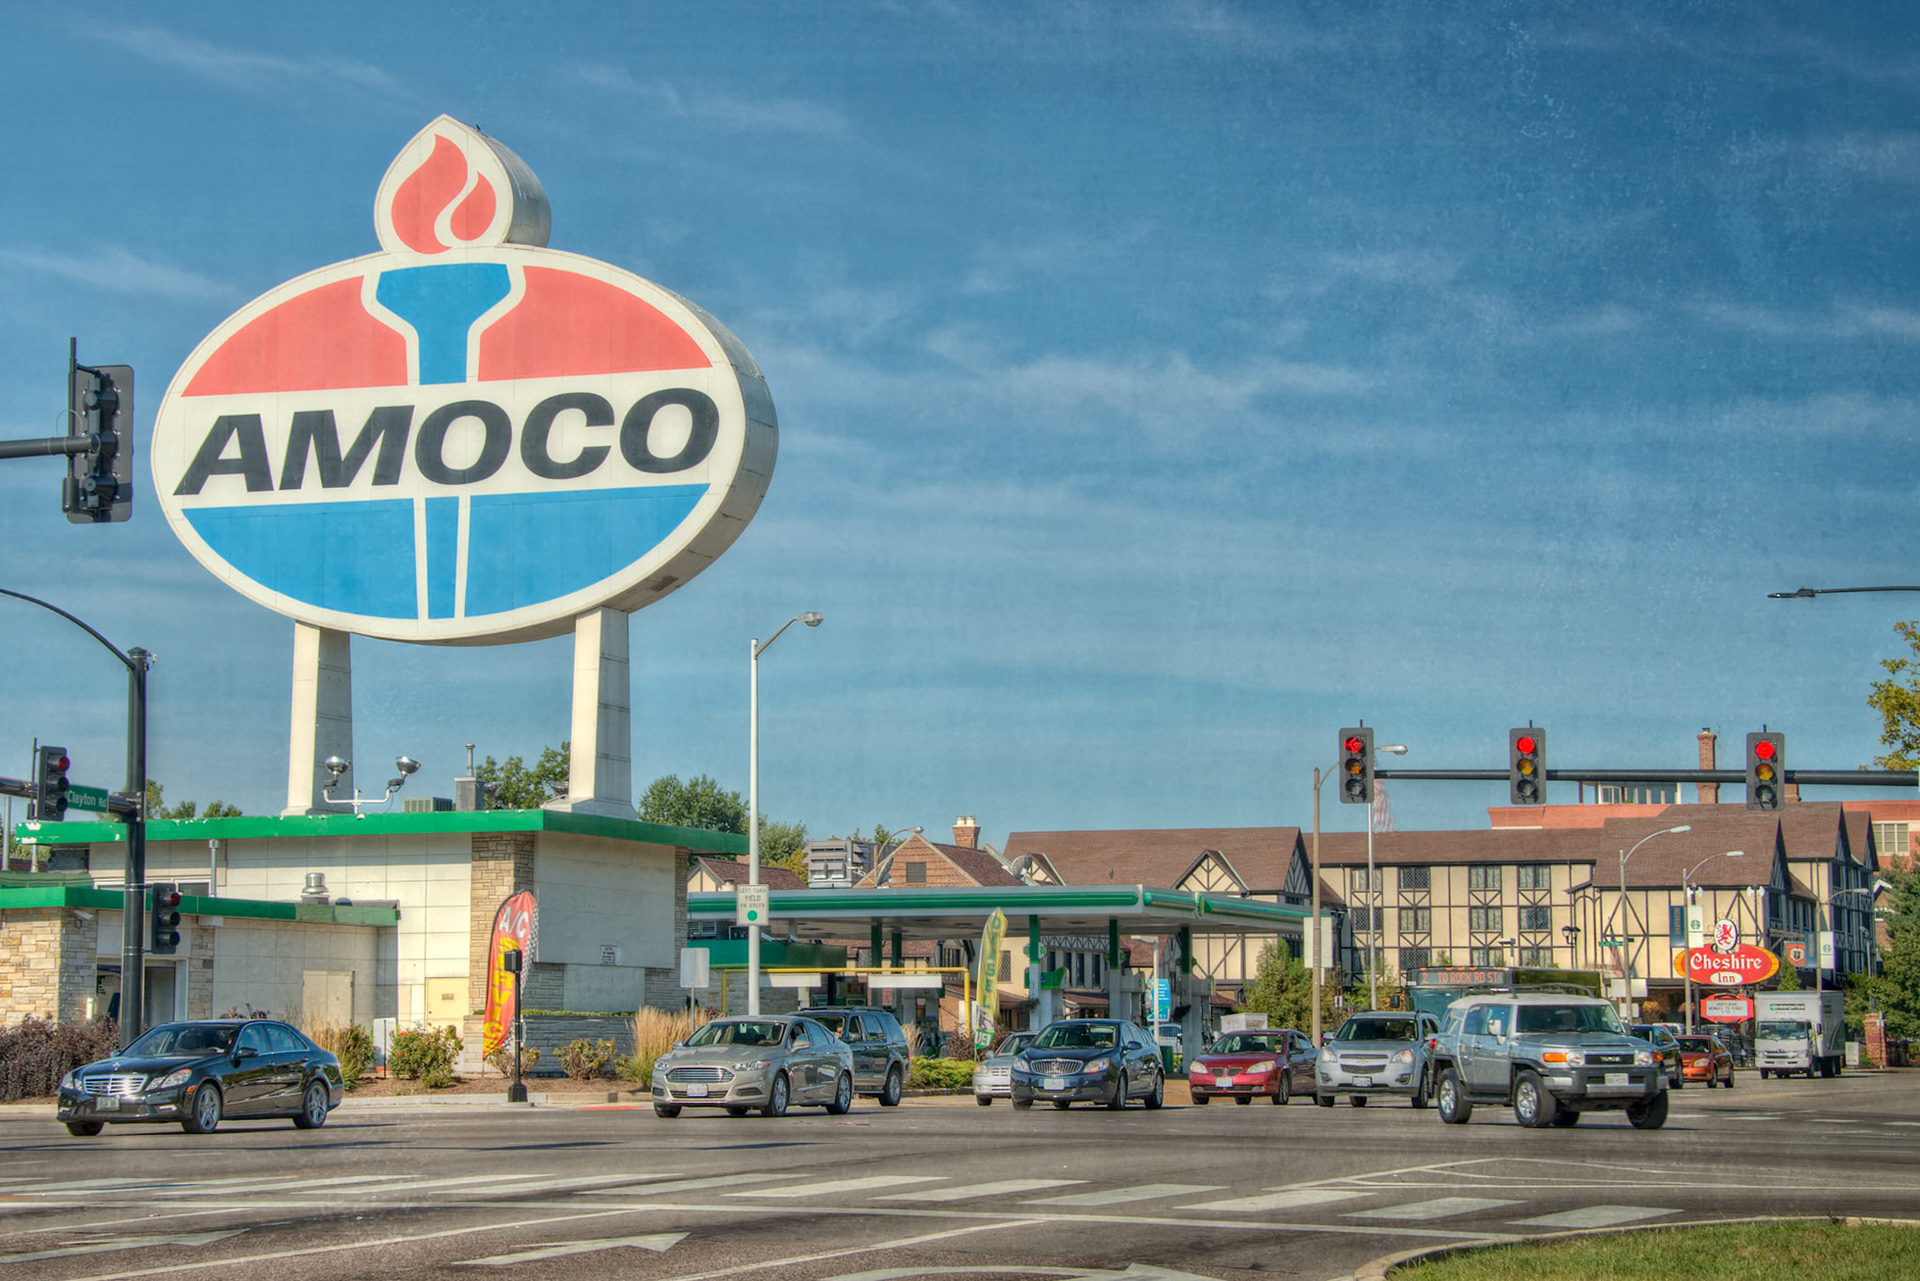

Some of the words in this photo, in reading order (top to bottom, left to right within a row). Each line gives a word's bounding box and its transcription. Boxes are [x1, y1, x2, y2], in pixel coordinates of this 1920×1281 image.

[173, 388, 720, 496] AMOCO
[67, 790, 96, 808] Clayton
[98, 797, 107, 808] Rd
[498, 906, 529, 939] A/C
[983, 916, 1000, 1009] DIESEL
[1690, 953, 1762, 970] Cheshire
[1422, 972, 1428, 983] 2
[1438, 972, 1448, 983] TO
[1451, 972, 1472, 983] ROCK
[1474, 972, 1486, 983] RD
[1488, 972, 1499, 983] ST
[1718, 973, 1736, 983] Inn
